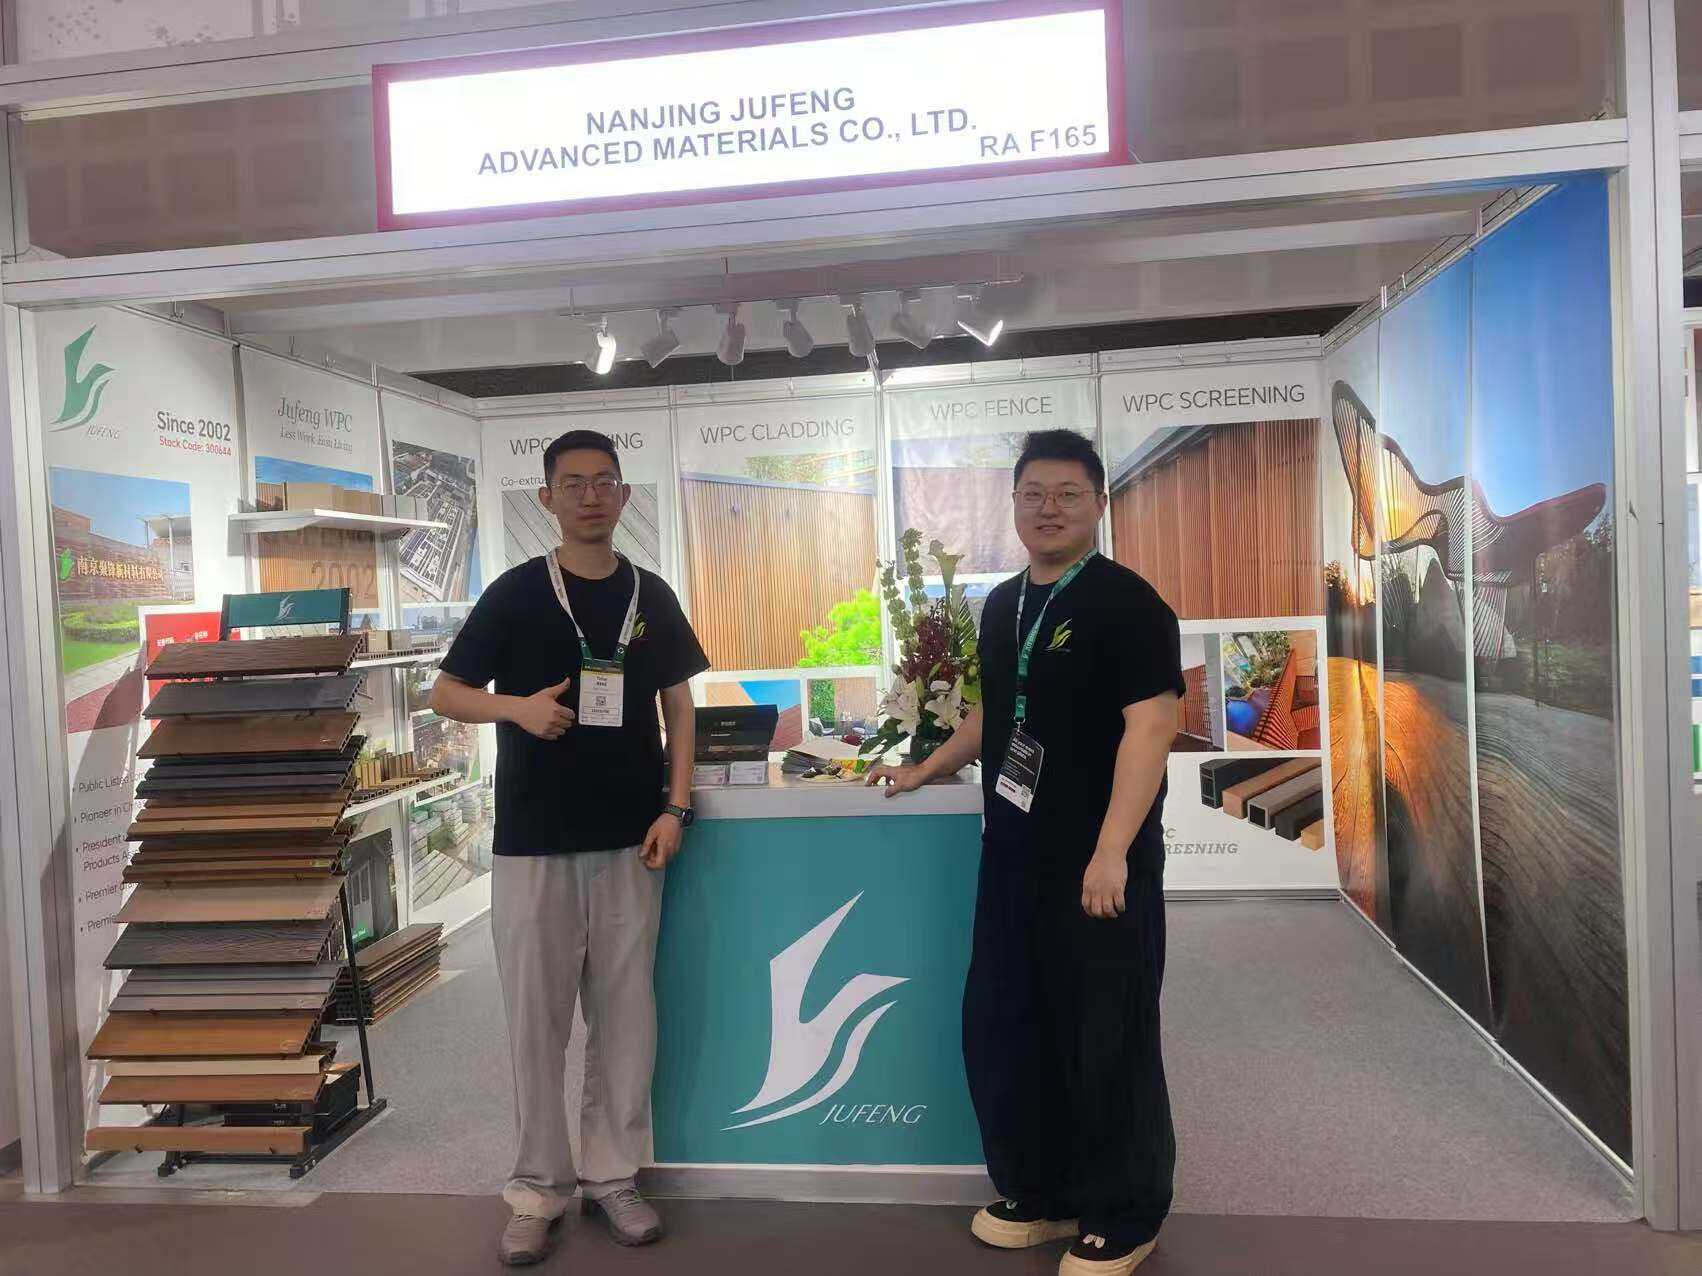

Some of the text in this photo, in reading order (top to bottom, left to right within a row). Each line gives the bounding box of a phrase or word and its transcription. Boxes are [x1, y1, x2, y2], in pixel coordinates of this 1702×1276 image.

[586, 87, 855, 135] NANJING JUFENG
[477, 108, 977, 175] ADVANCED MATERIALS CO., LTD.
[980, 124, 1097, 157] RA F165
[928, 396, 1054, 420] WPC FENCE
[1123, 384, 1306, 413] WPC SCREENING
[277, 396, 353, 433] Jufeng WPC
[86, 425, 121, 440] JUFENG
[156, 411, 232, 442] Since 2002
[700, 418, 855, 444] WPC CLADDING
[159, 435, 181, 449] Stock
[182, 439, 203, 452] Code:
[79, 780, 104, 793] Public
[80, 808, 113, 823] Pioneer
[82, 834, 123, 852] President
[1163, 842, 1239, 855] REENING
[83, 854, 120, 872] Products
[86, 884, 117, 901] Premier
[819, 1103, 928, 1126] JUFENG
